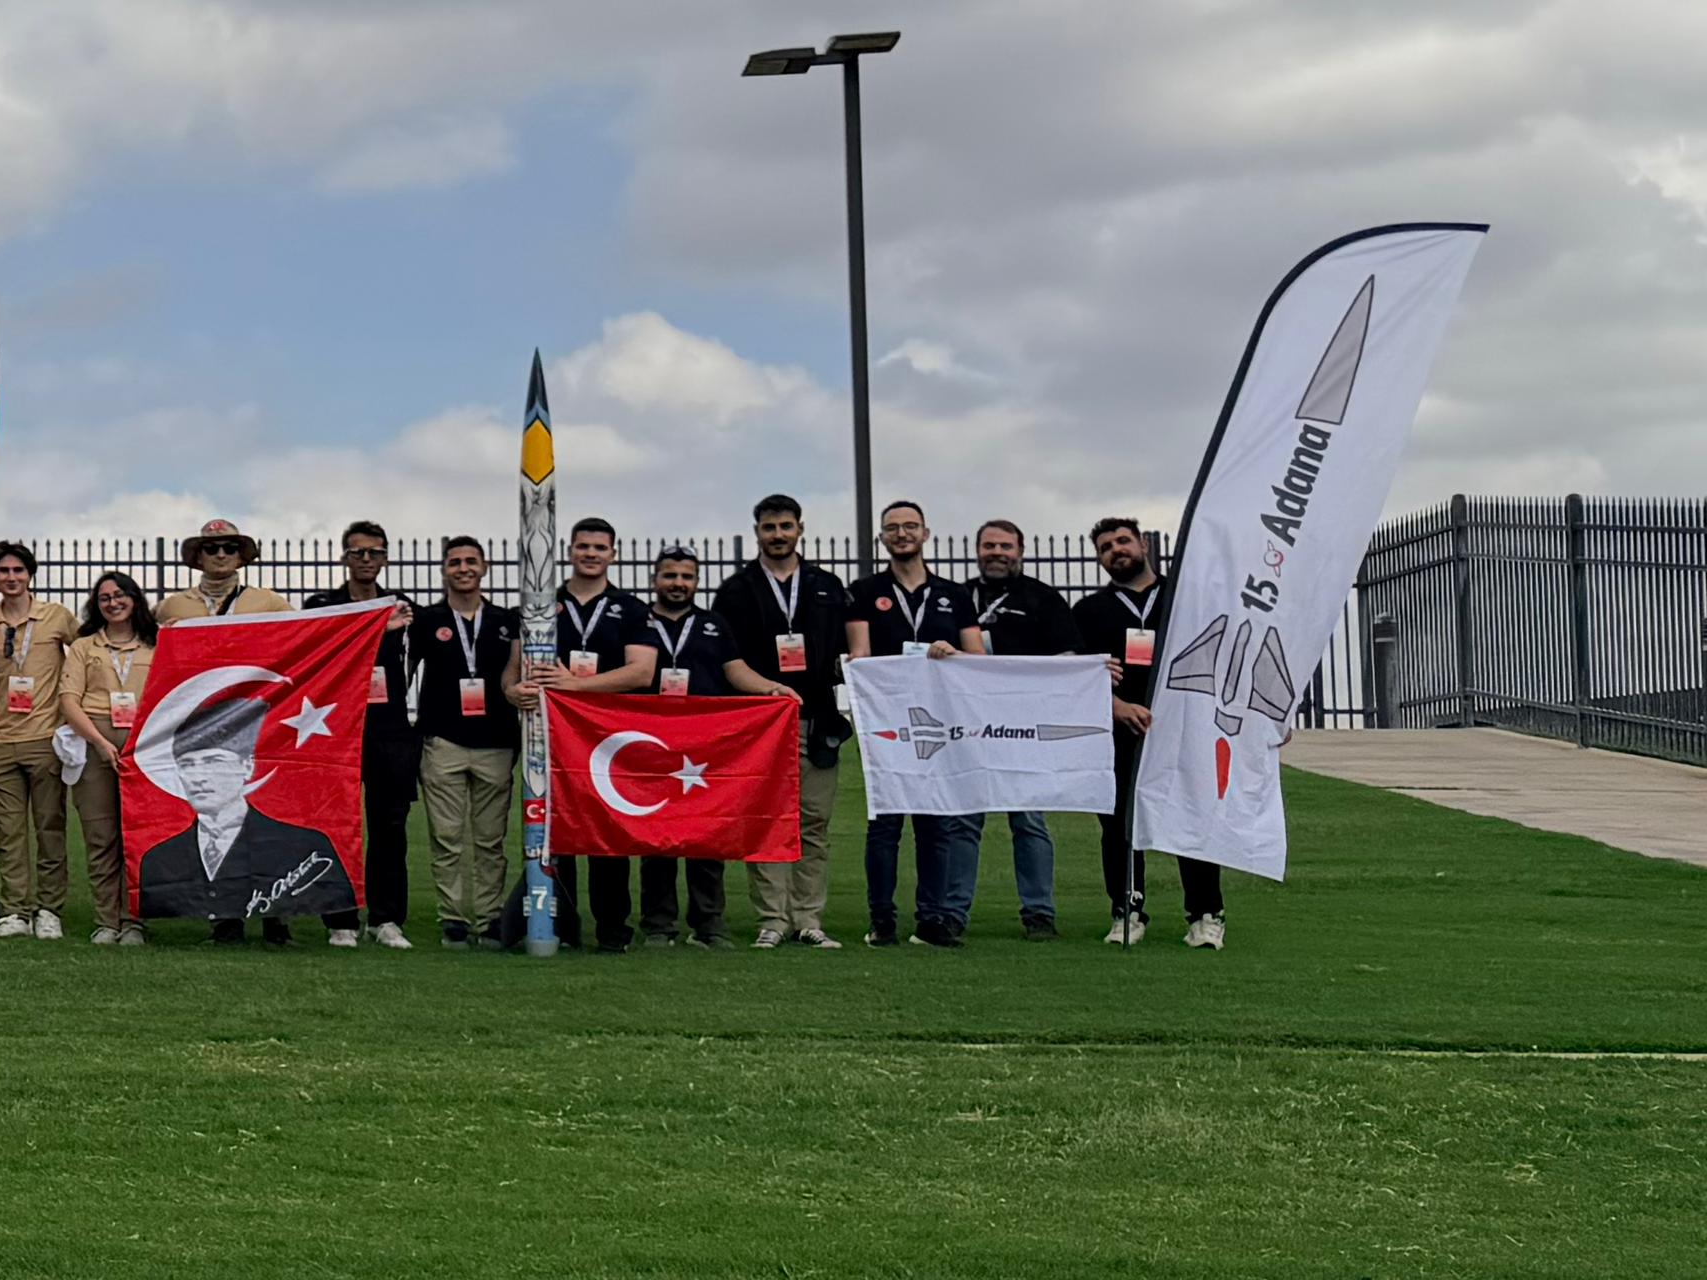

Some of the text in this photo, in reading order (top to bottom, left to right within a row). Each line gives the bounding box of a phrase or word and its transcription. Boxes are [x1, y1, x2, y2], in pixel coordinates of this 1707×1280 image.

[1260, 423, 1332, 548] Adana
[980, 723, 1036, 739] Adana
[531, 890, 548, 910] 7
